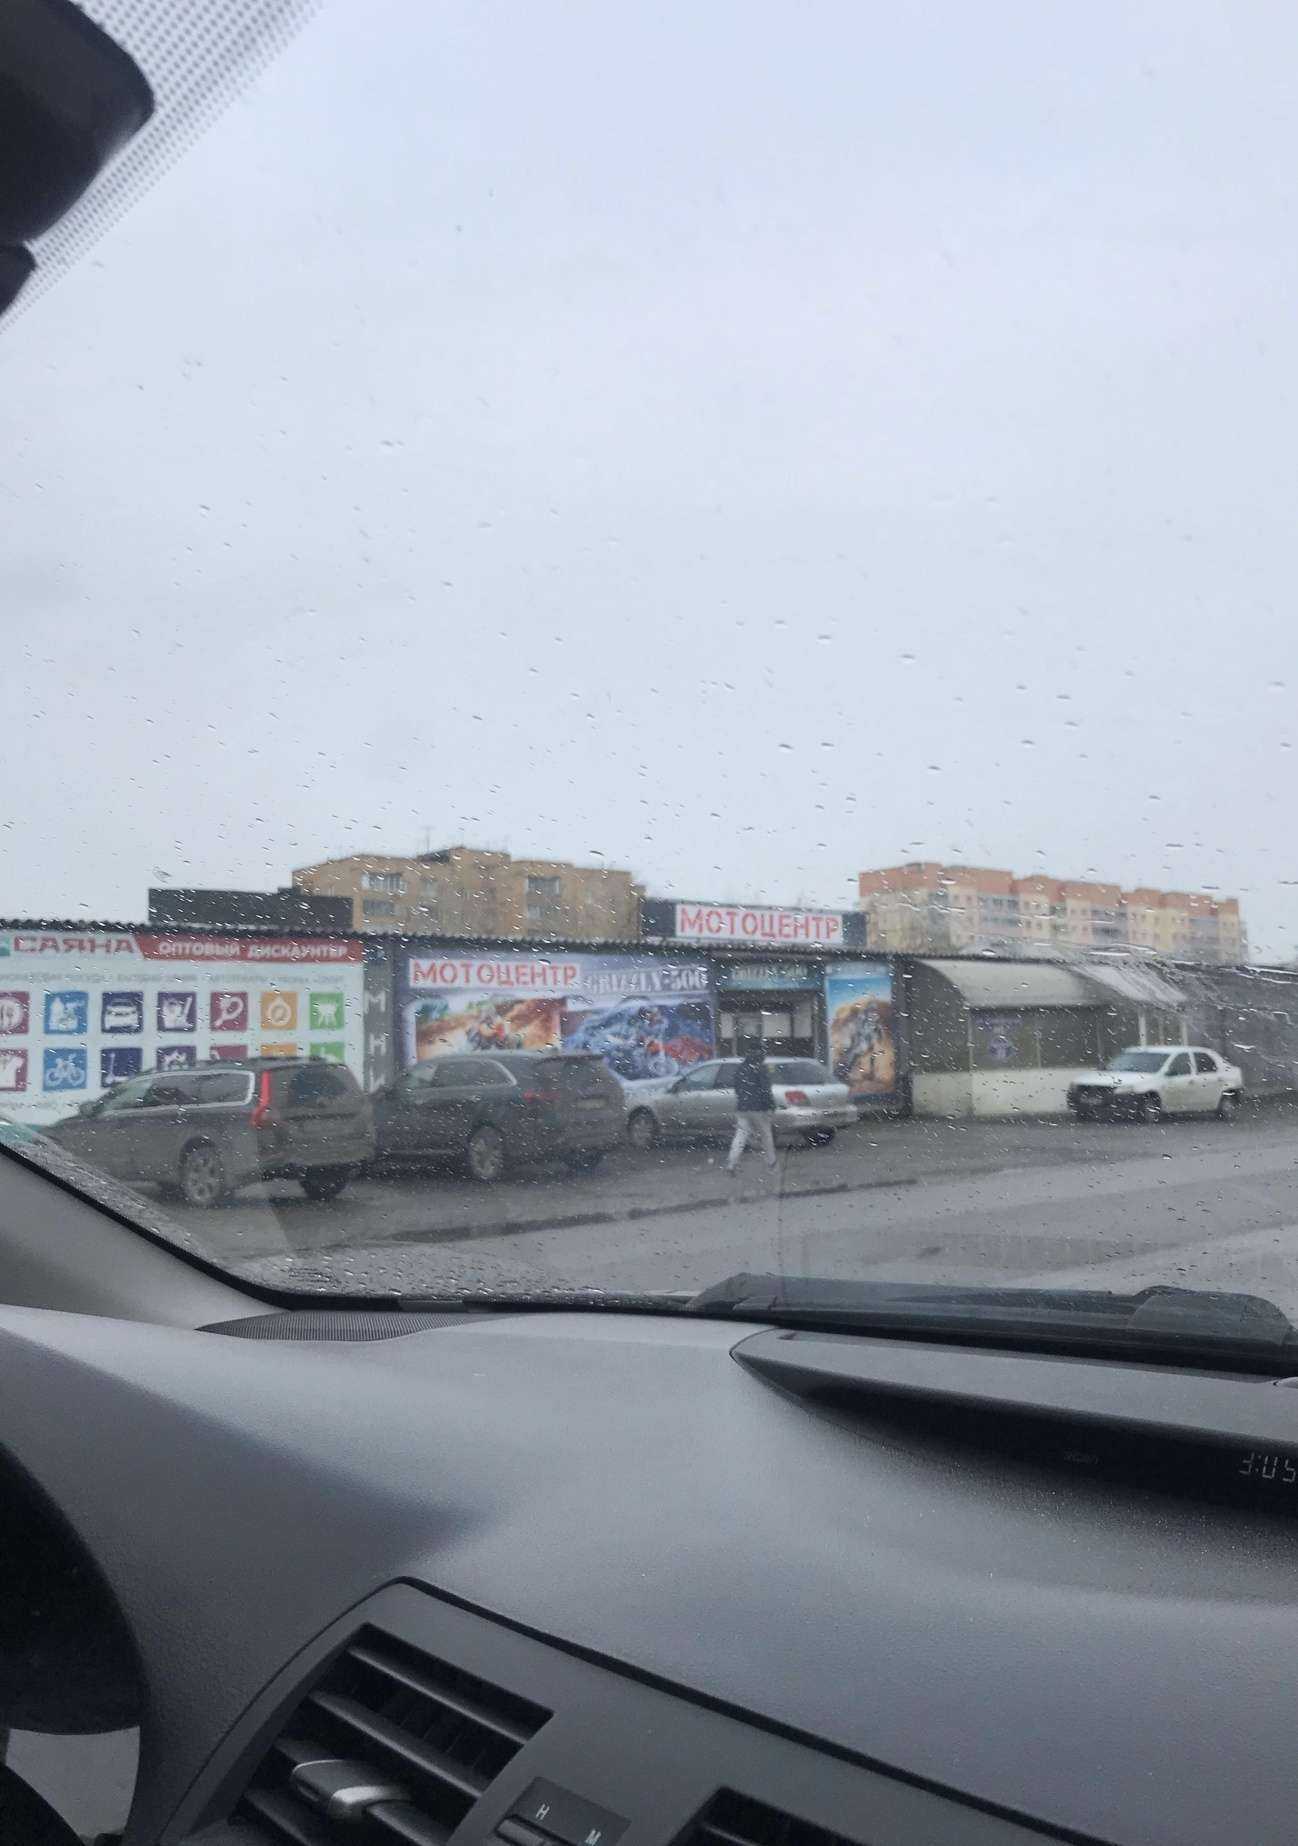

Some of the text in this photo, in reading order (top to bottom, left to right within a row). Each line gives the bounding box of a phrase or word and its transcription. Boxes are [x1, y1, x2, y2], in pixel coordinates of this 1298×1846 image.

[680, 907, 840, 942] МОТОЦЕНТР
[14, 936, 134, 953] САЯНА
[411, 959, 577, 987] МОТОЦЕНТР
[535, 1803, 550, 1820] H
